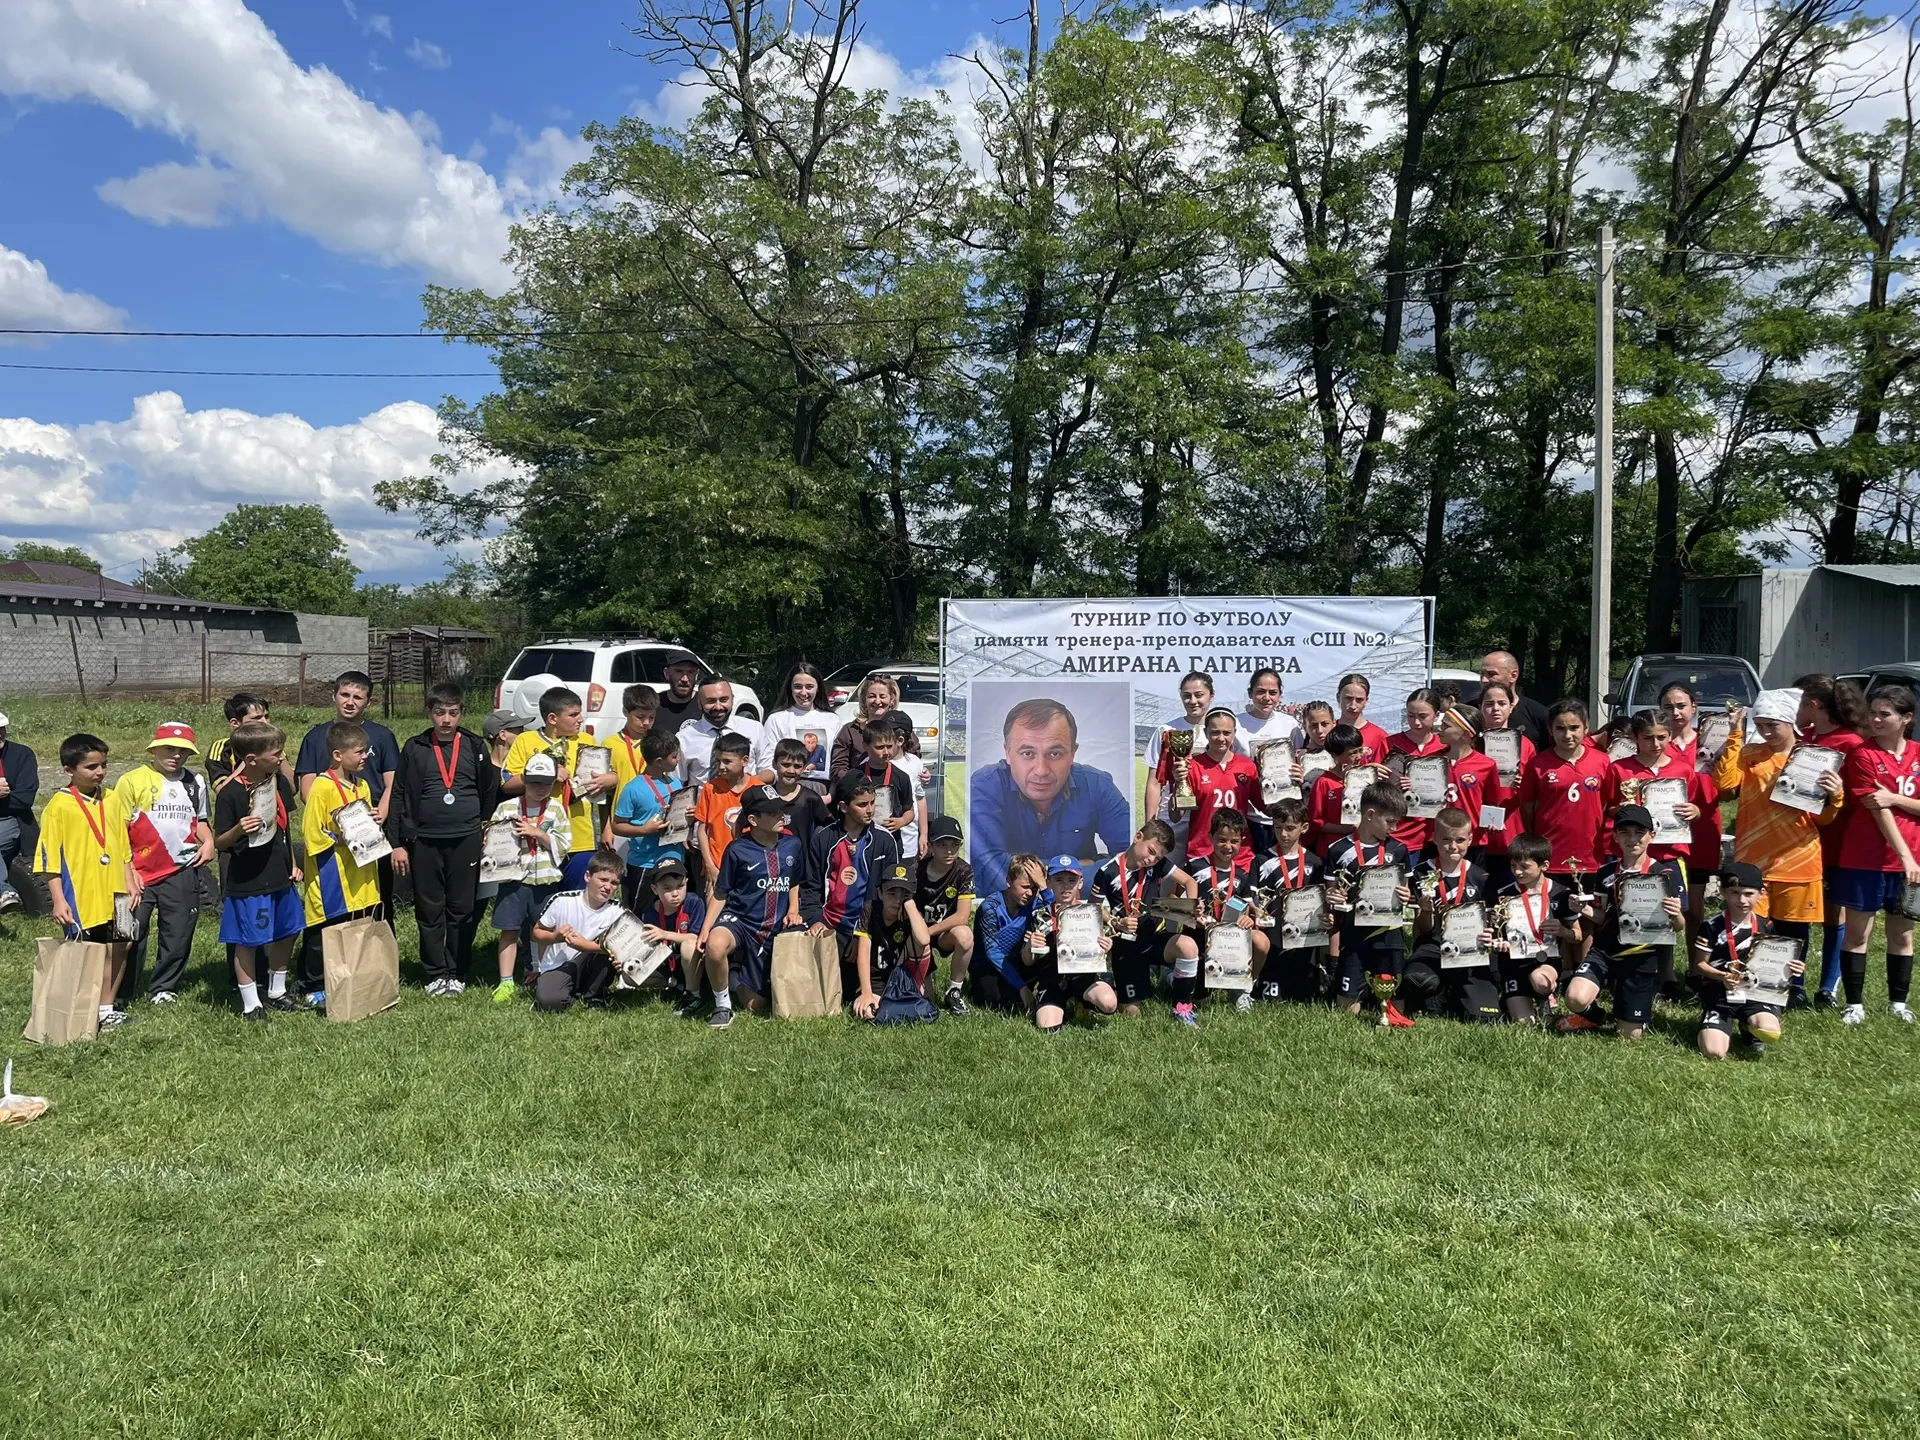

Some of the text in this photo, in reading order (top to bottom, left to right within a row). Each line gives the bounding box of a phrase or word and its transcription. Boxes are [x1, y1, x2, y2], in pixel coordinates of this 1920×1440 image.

[1071, 612, 1292, 626] ТУРНИР ПО ФУТБОЛУ
[974, 632, 1394, 650] памяти тренера-преподавателя «СШ №2»
[1061, 656, 1302, 674] АМИРАНА ГАГИЕВА
[1568, 782, 1580, 803] 6
[1896, 775, 1916, 797] 16
[1213, 788, 1236, 808] 20
[152, 803, 192, 812] Emirates
[756, 876, 790, 890] QATAR
[255, 908, 270, 930] 5
[1761, 943, 1788, 953] ГРАМОТА
[1126, 984, 1136, 998] 6
[1262, 981, 1278, 996] 28
[1342, 976, 1350, 992] 5
[1505, 980, 1518, 993] 13
